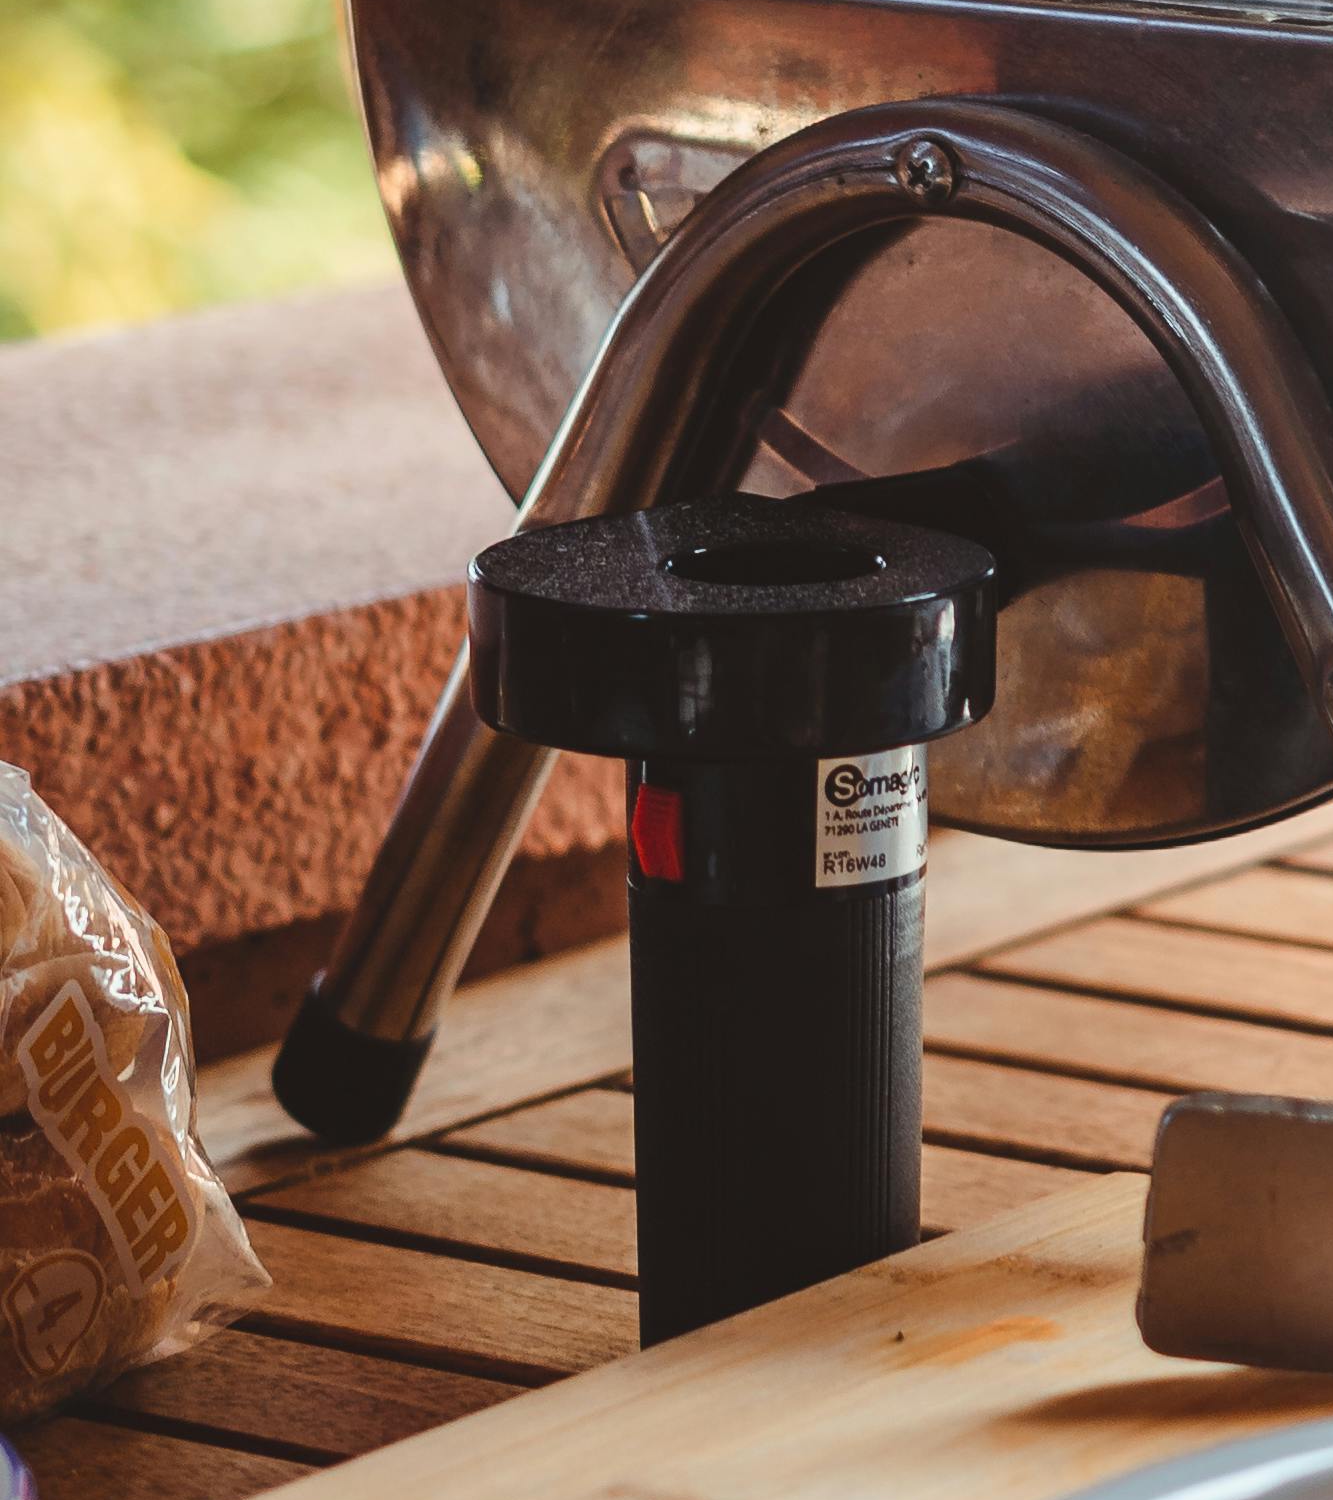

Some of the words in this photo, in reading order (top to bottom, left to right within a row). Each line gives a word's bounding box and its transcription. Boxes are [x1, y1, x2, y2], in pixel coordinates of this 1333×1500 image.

[826, 764, 920, 803] Somagc
[845, 806, 872, 819] Route
[856, 822, 868, 834] LA
[29, 996, 188, 1283] BURGER
